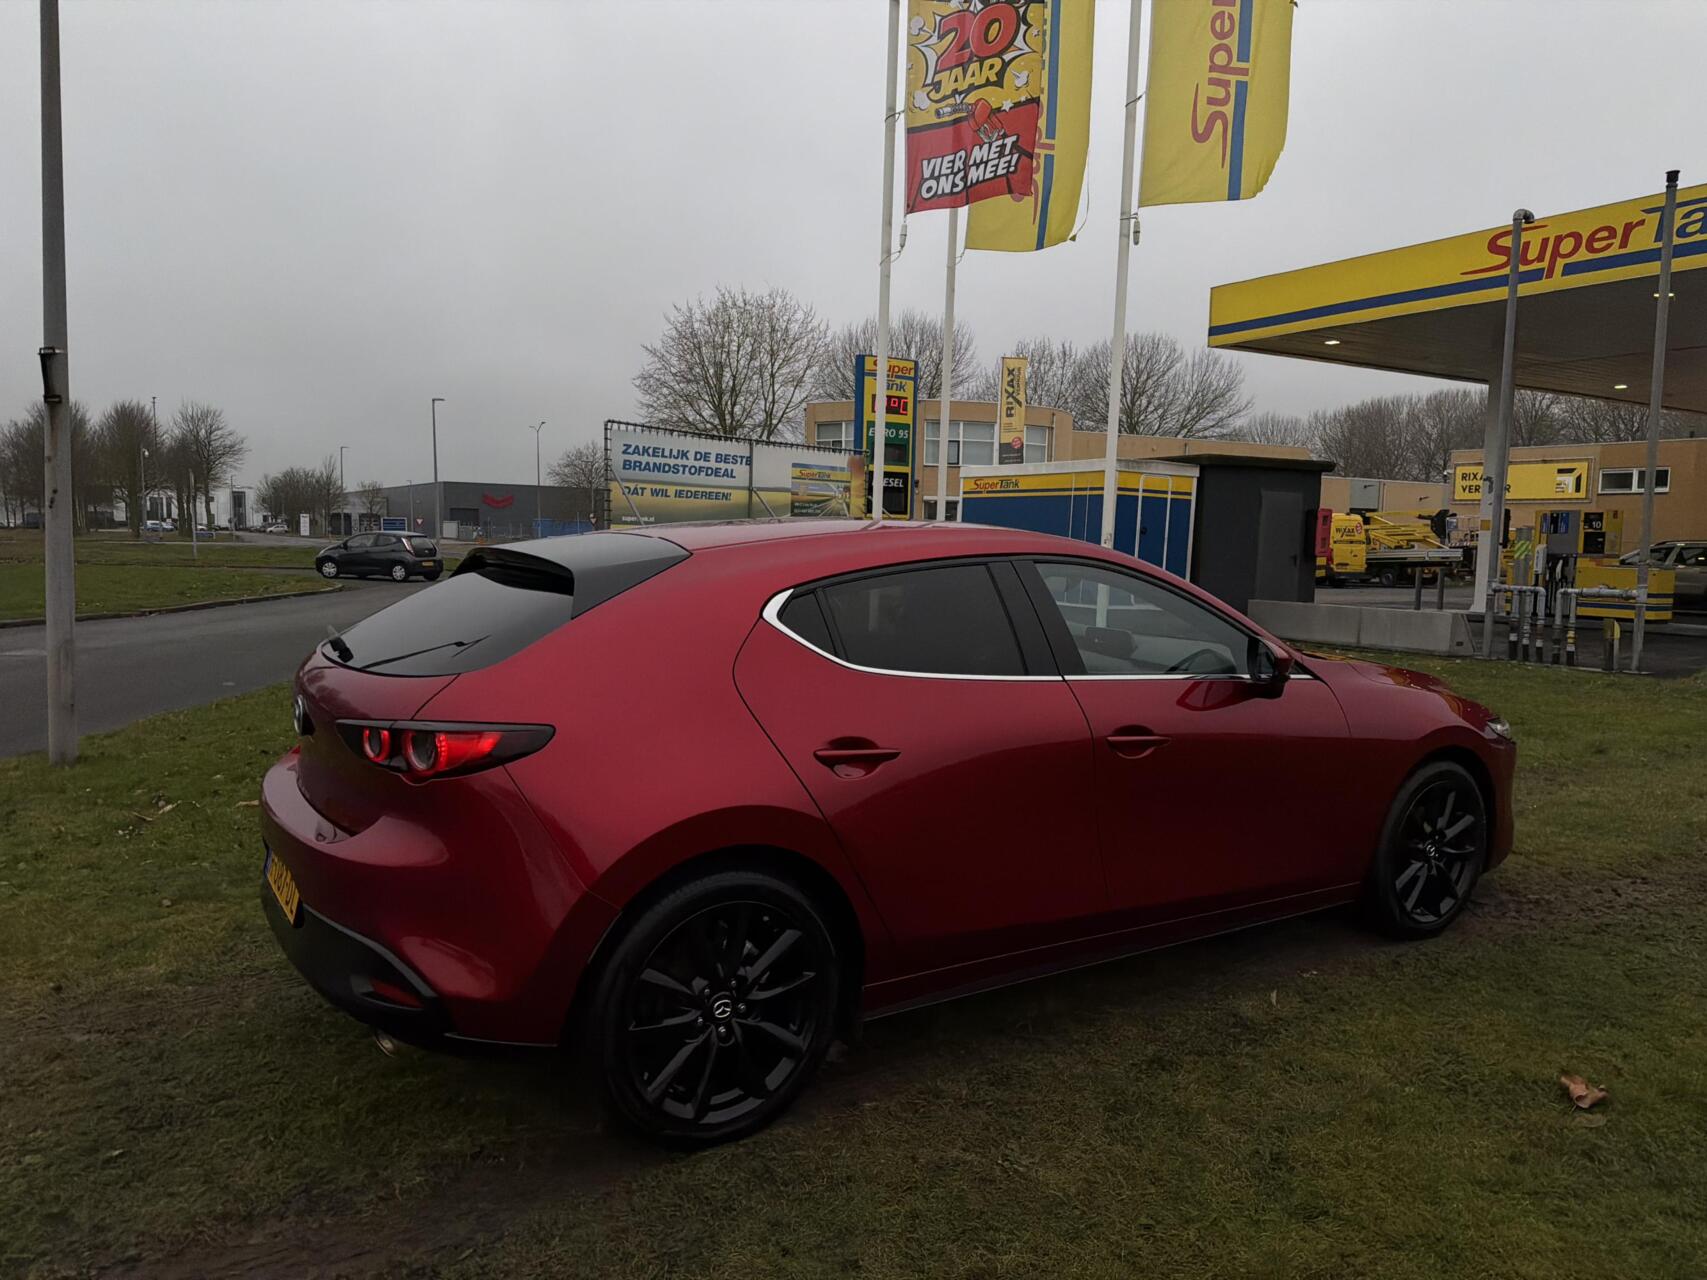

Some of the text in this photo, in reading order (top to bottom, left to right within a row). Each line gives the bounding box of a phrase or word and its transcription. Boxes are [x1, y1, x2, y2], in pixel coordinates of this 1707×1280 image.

[937, 3, 1018, 71] 20
[930, 57, 1002, 100] JAAR
[922, 135, 1018, 178] VIER MET
[921, 153, 1019, 199] ONS MEE!
[868, 427, 909, 439] ERO 95
[621, 443, 752, 466] ZAKELIJK DE BESTE
[622, 458, 737, 479] BRANDSTOFDEAL
[650, 487, 671, 498] WIL
[674, 488, 732, 501] IEDEREEN!
[968, 478, 1020, 494] SuperTank
[1461, 484, 1511, 494] VERR
[1592, 521, 1602, 529] 10
